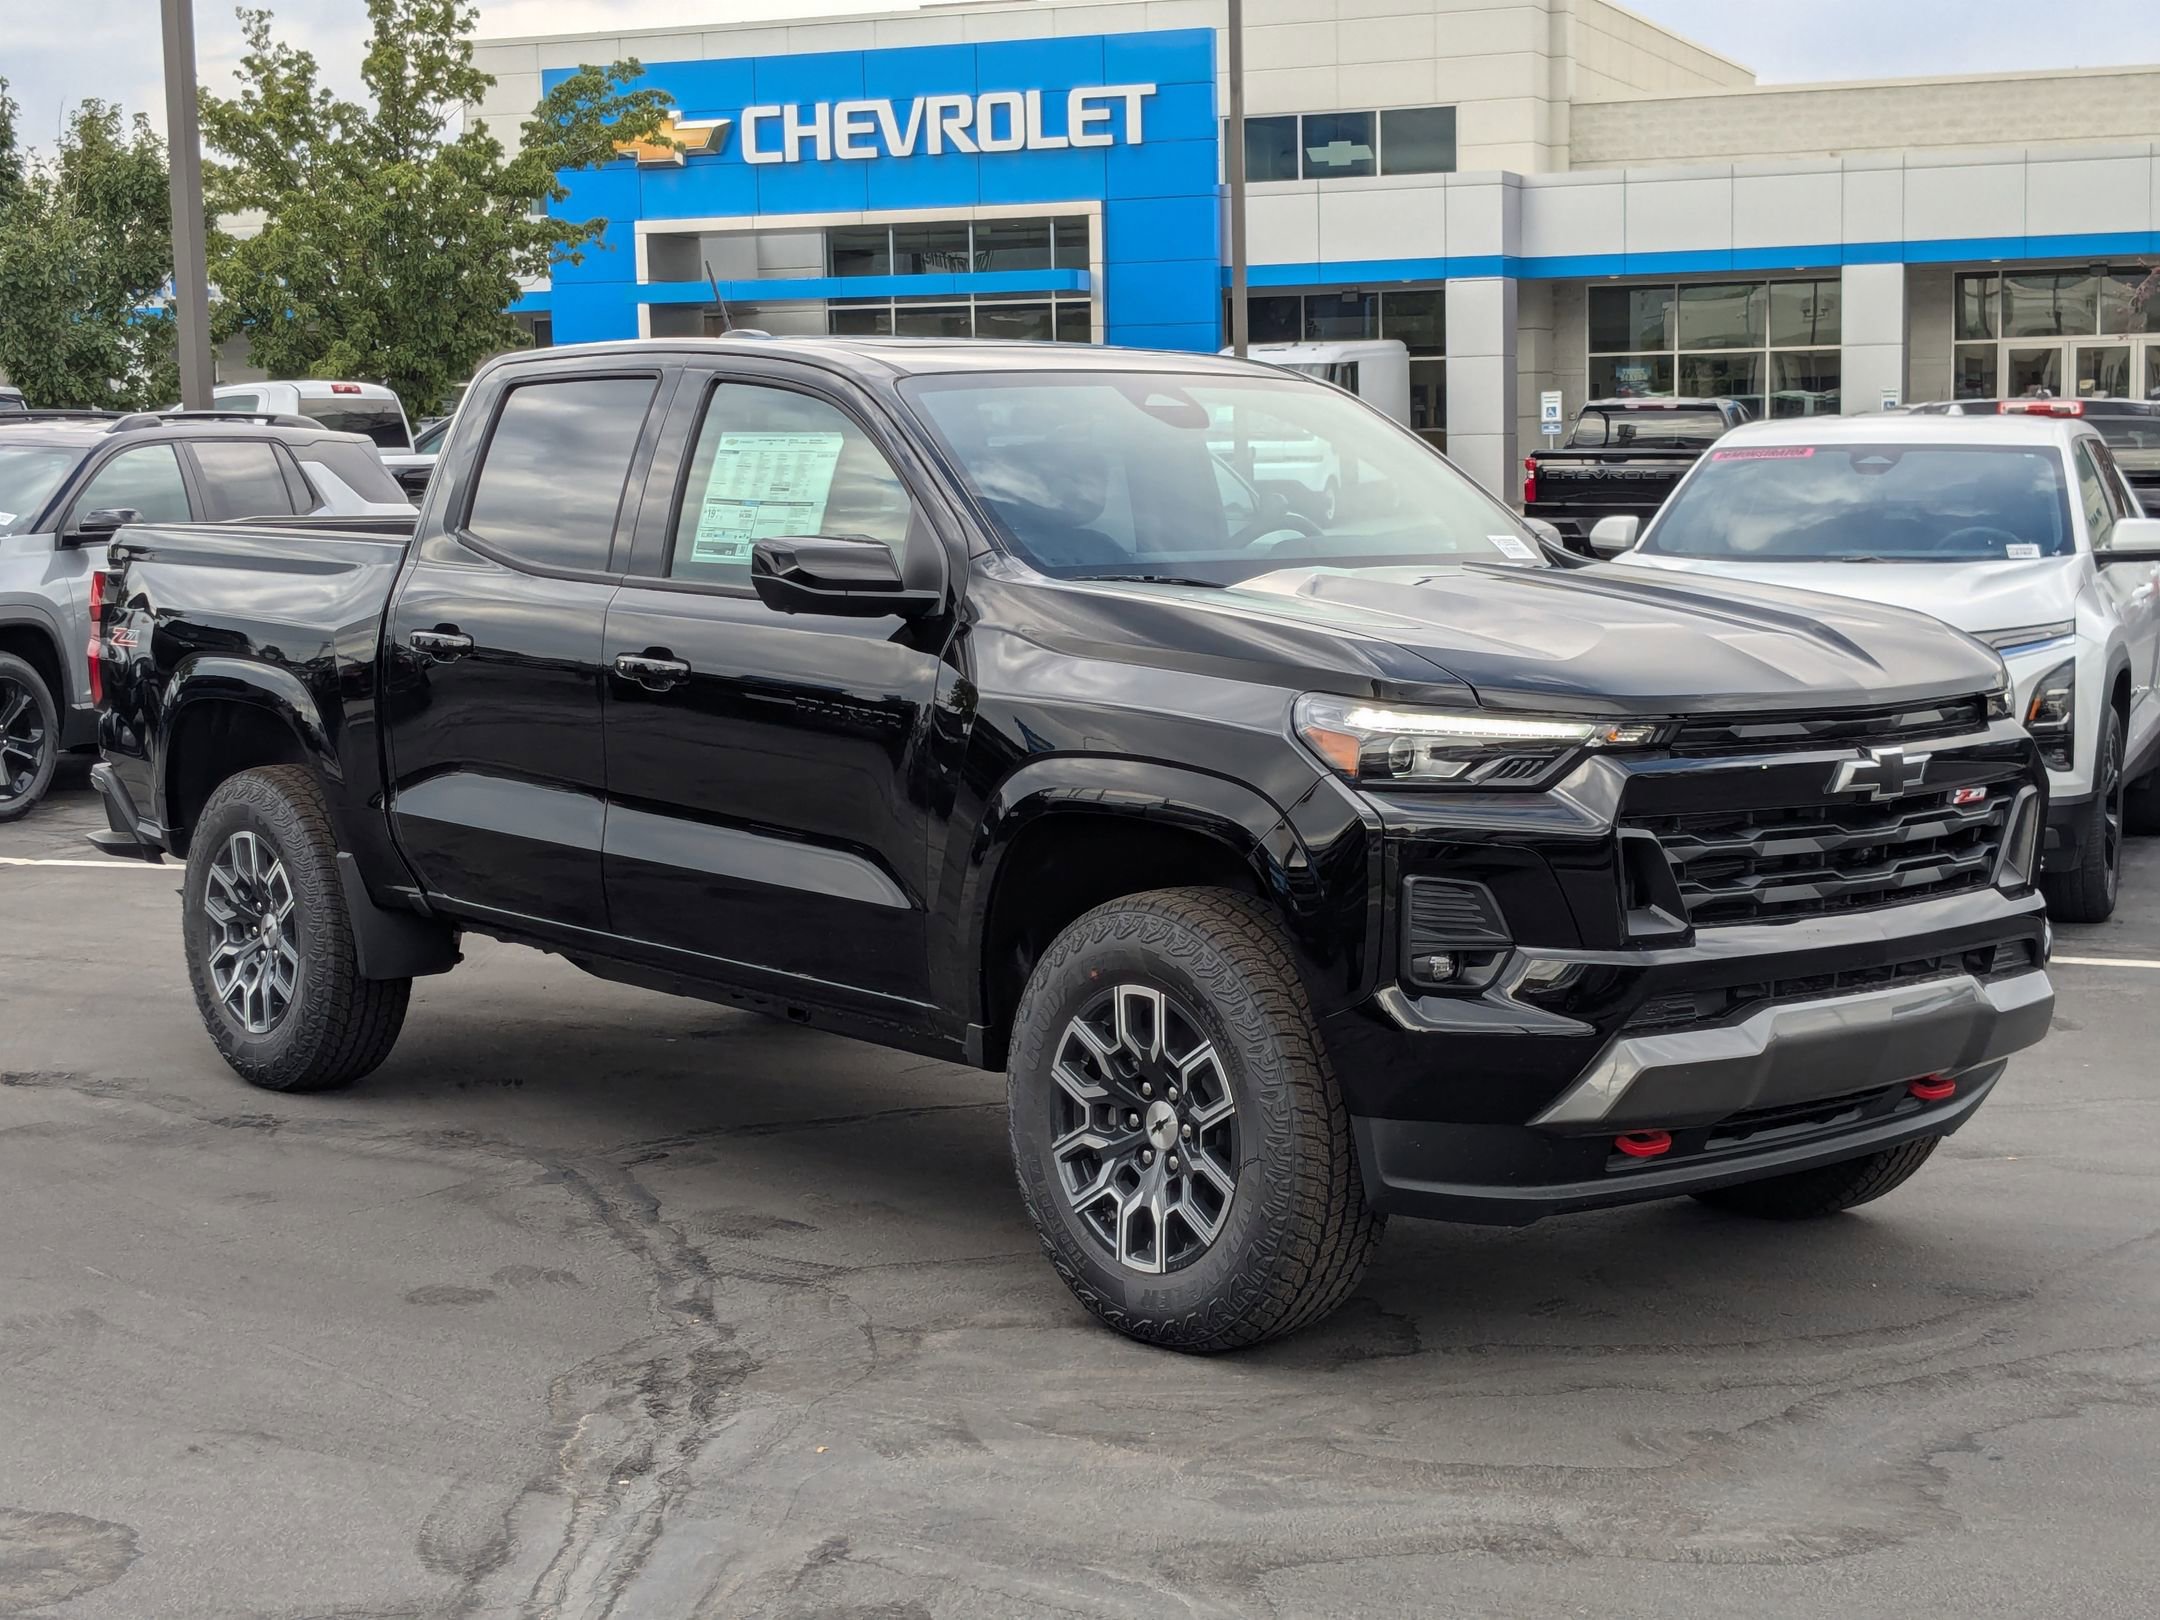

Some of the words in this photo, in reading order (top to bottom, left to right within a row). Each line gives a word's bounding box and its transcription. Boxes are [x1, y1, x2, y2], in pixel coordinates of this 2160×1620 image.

[741, 84, 1157, 164] CHEVROLET
[110, 626, 141, 647] Z71
[1953, 786, 1987, 804] Z71
